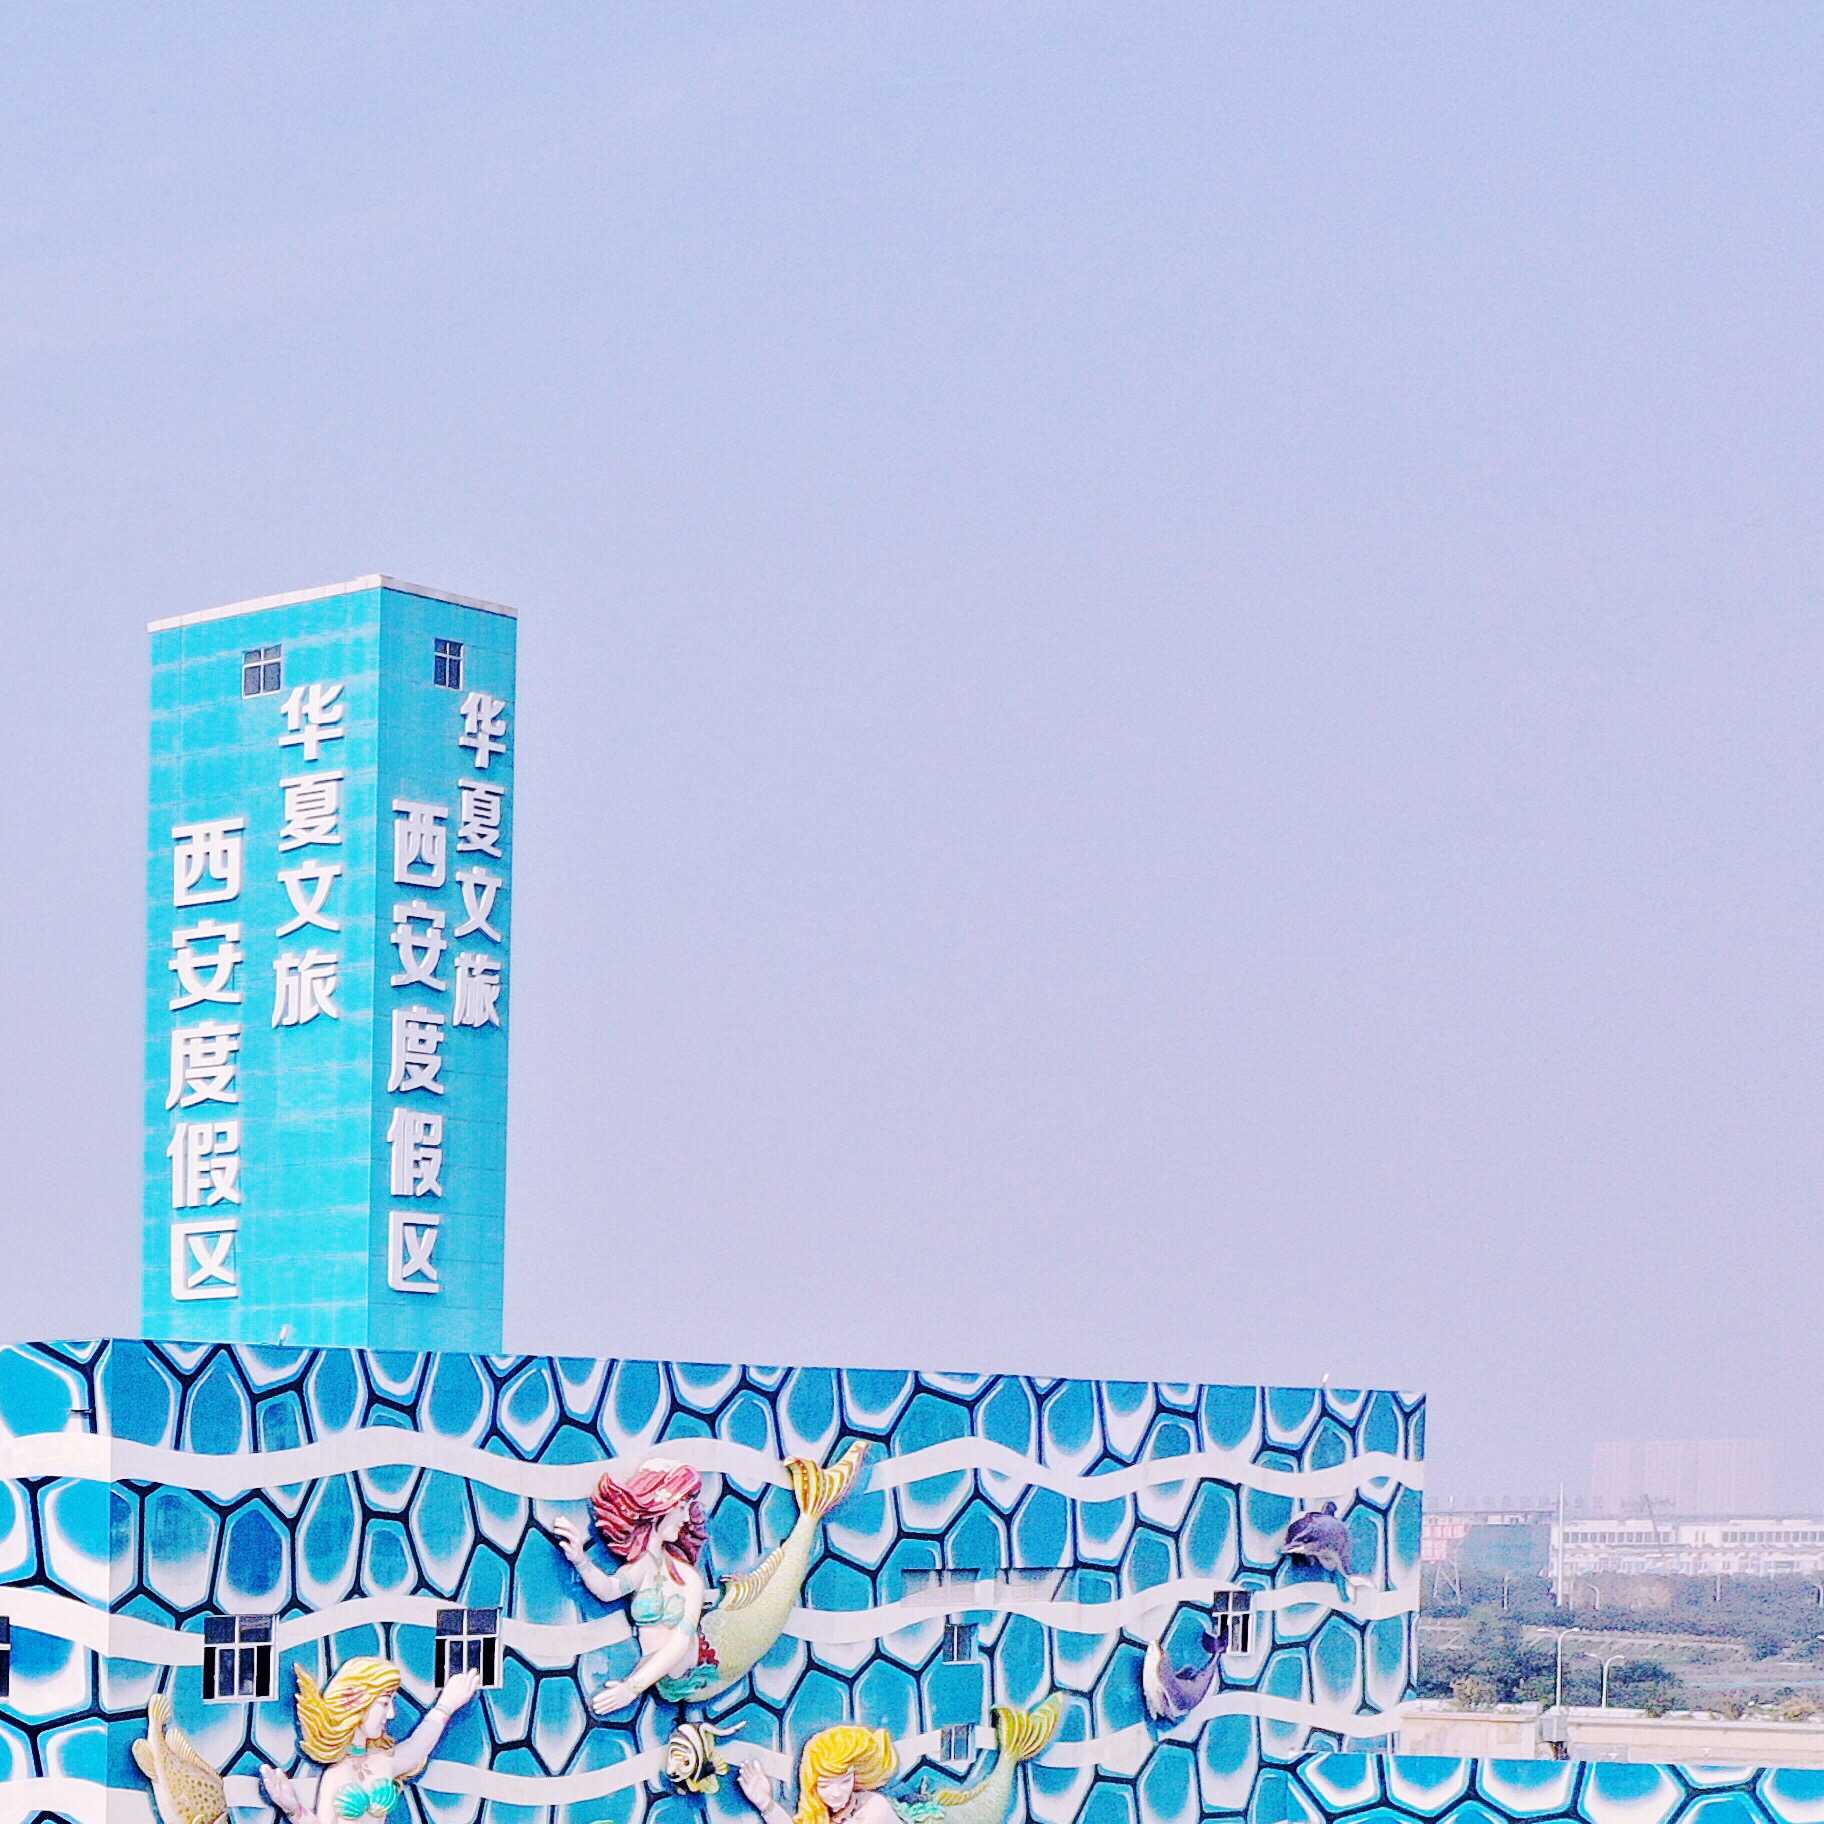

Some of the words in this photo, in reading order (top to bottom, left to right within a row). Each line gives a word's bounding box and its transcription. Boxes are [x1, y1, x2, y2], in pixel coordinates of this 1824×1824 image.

[165, 817, 245, 1301] 西安度假区
[272, 684, 344, 1028] 华夏文旅
[387, 798, 449, 1295] 西安度假区
[453, 692, 507, 1028] 华夏文旅
